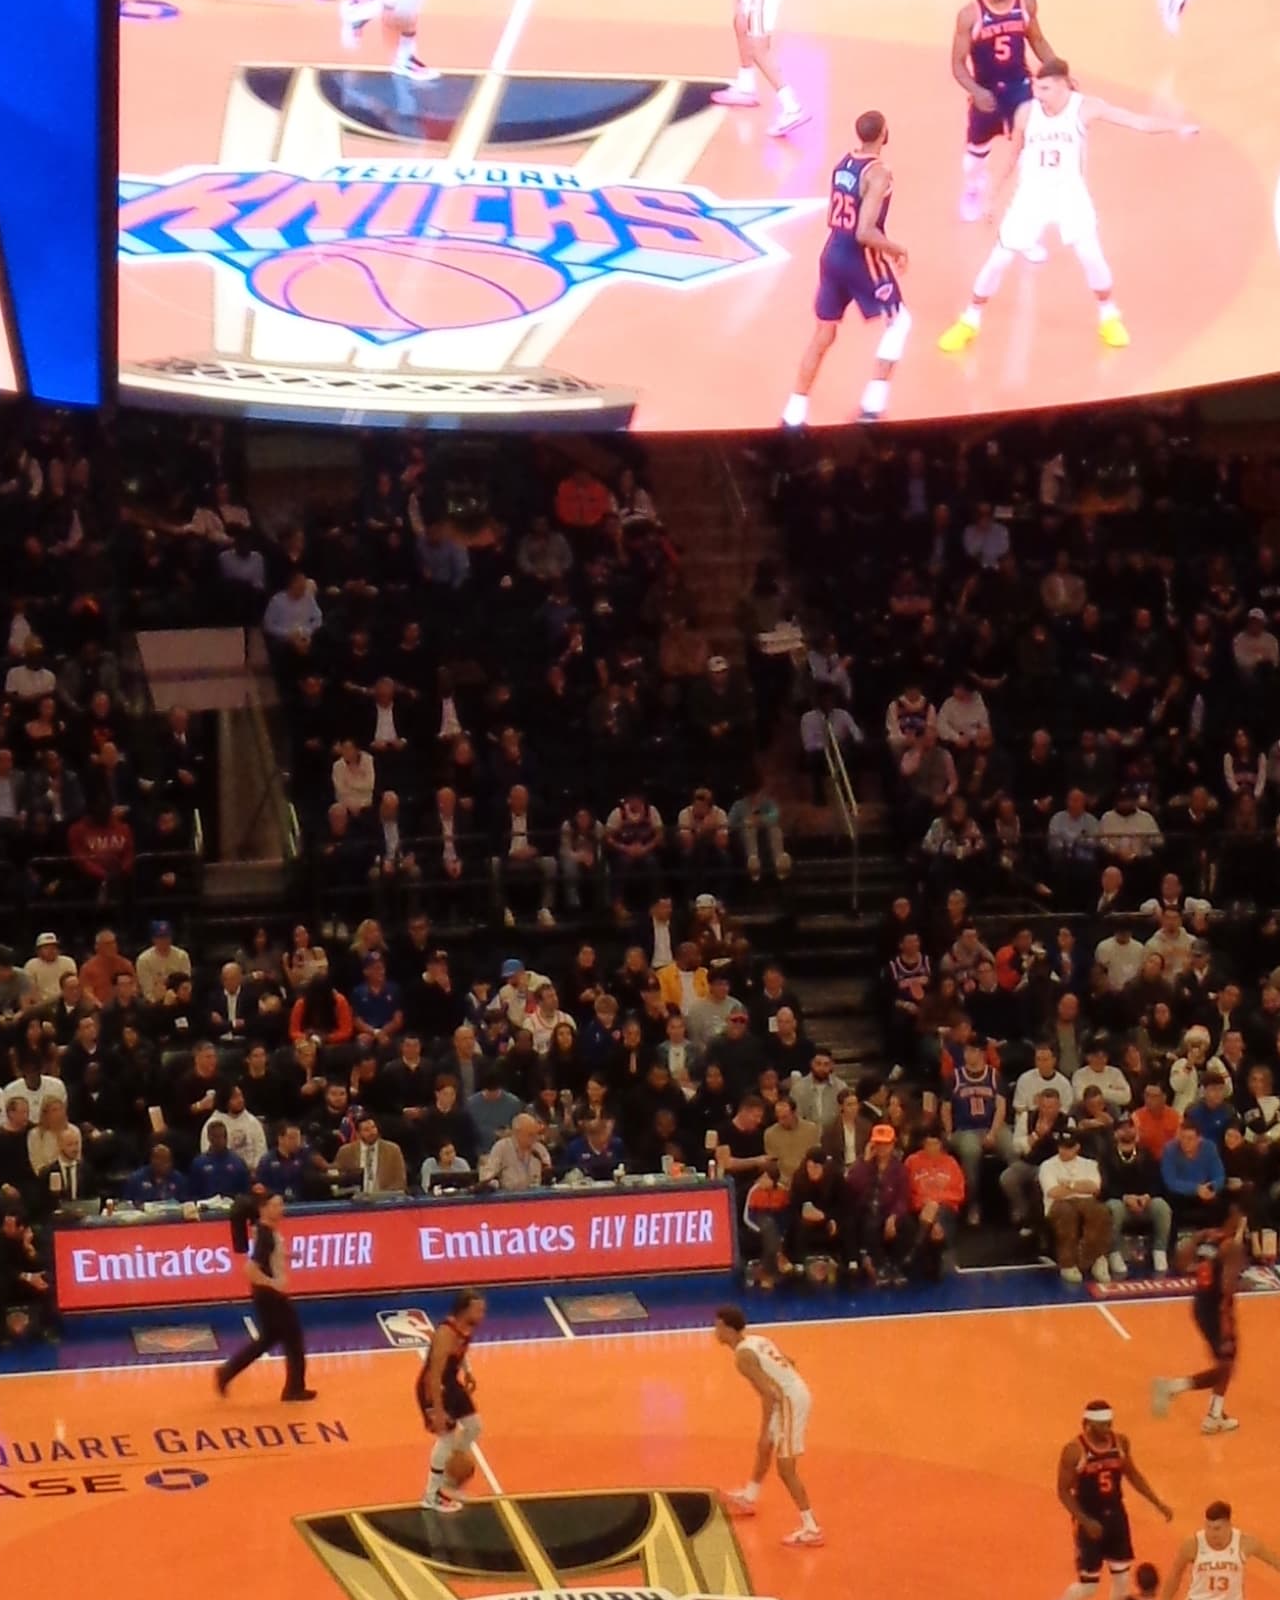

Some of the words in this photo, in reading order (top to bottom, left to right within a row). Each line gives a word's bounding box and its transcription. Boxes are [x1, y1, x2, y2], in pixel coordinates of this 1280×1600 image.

[994, 35, 1012, 61] 5
[1039, 149, 1061, 168] 13
[120, 170, 764, 266] KNICKS
[831, 190, 856, 229] 25
[418, 1221, 576, 1261] Emirates
[590, 1215, 627, 1249] FLY
[634, 1209, 714, 1248] BETTER
[71, 1244, 233, 1284] Emirates
[153, 1420, 350, 1454] GARDEN
[1208, 1576, 1229, 1592] 13
